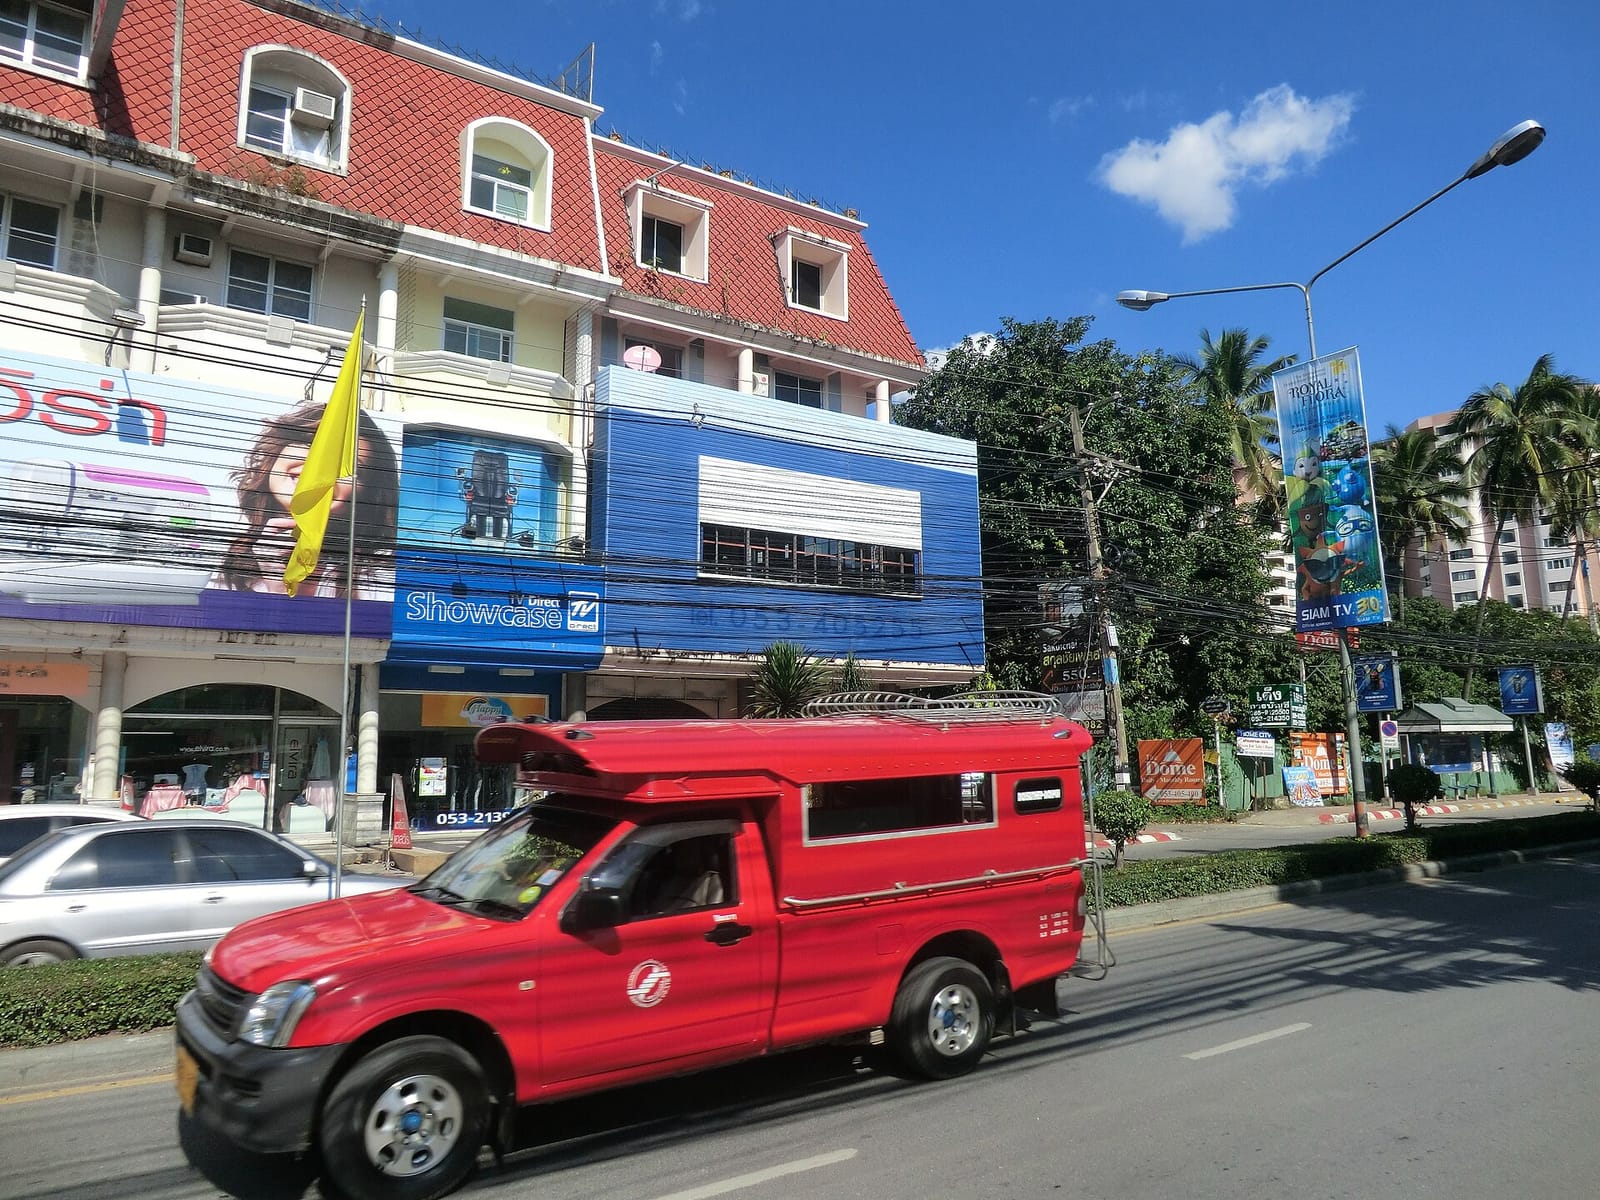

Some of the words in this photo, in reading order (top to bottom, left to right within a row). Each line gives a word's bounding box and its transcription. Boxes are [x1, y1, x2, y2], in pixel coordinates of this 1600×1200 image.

[406, 591, 563, 629] Showcase
[1301, 606, 1330, 621] SIAM
[1333, 603, 1355, 616] T.V.
[1145, 761, 1197, 776] Dome
